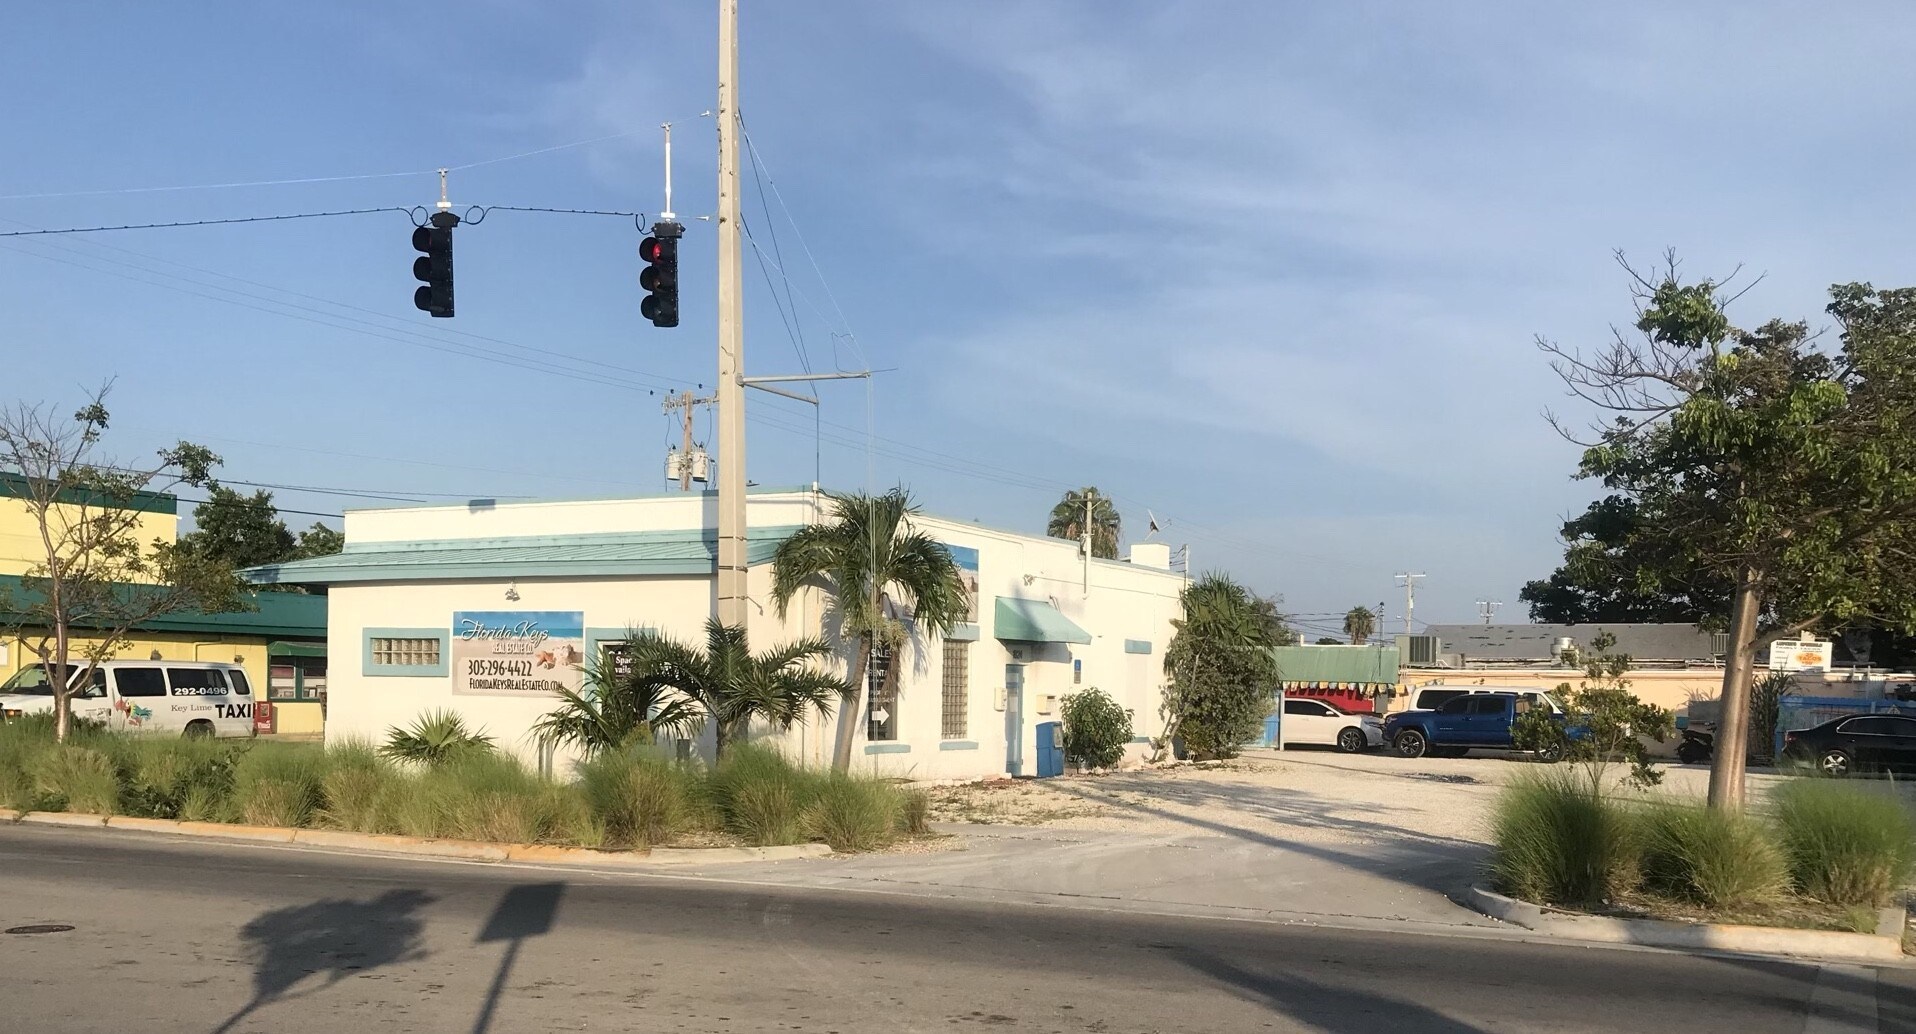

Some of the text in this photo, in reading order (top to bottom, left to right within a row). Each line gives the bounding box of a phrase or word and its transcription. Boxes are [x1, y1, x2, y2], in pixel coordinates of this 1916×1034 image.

[461, 618, 549, 649] Florida Keys
[174, 687, 228, 696] 292-0496
[171, 704, 213, 713] Key Lime
[214, 703, 252, 719] TAXI
